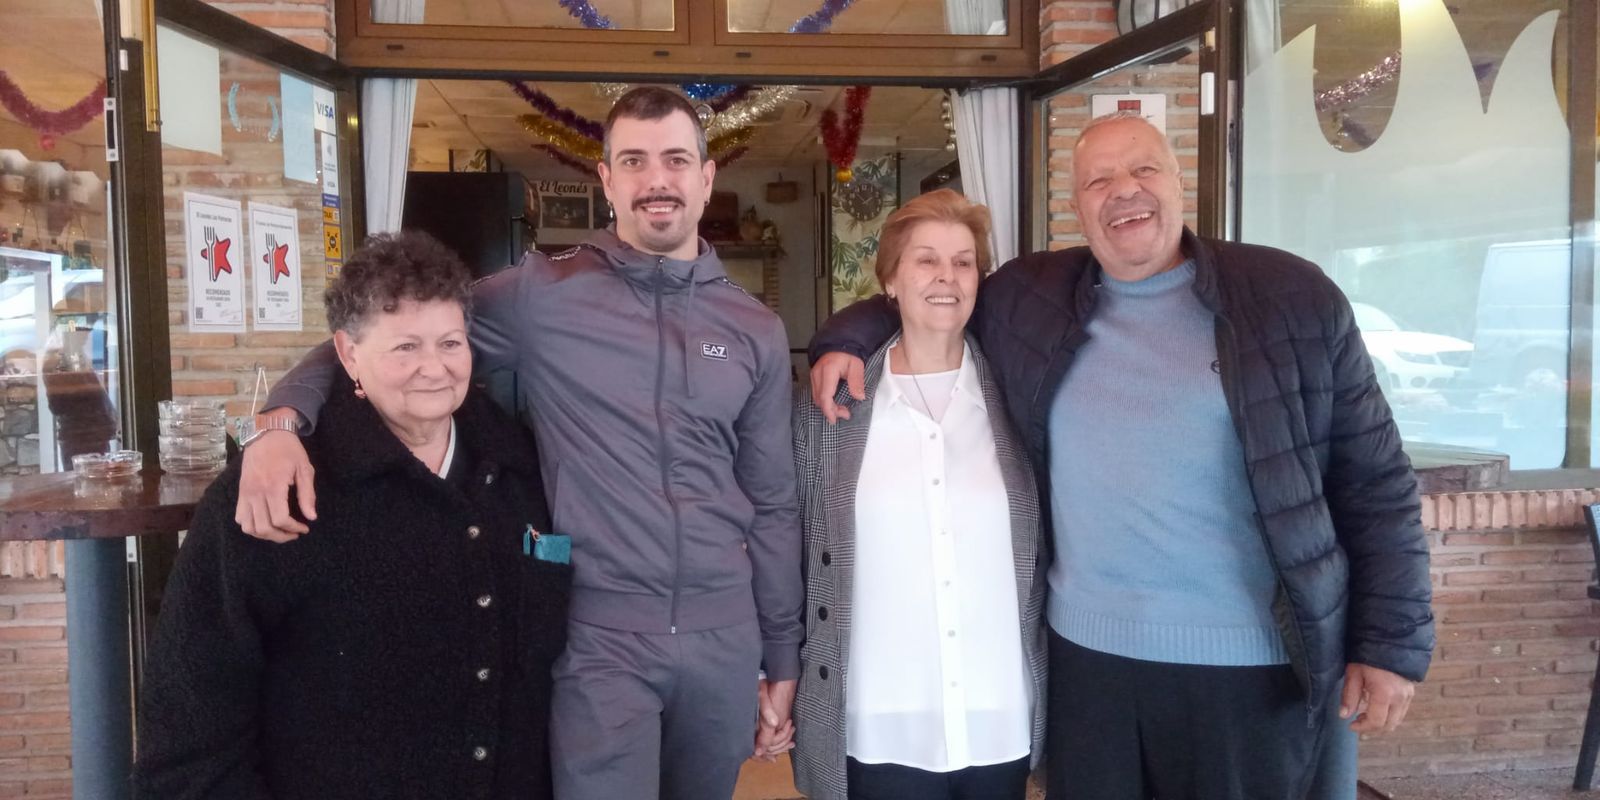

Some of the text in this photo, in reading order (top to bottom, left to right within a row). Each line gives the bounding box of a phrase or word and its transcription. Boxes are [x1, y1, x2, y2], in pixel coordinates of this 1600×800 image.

[315, 100, 334, 119] VISA
[540, 180, 588, 196] El Leonés
[702, 343, 726, 356] EA7
